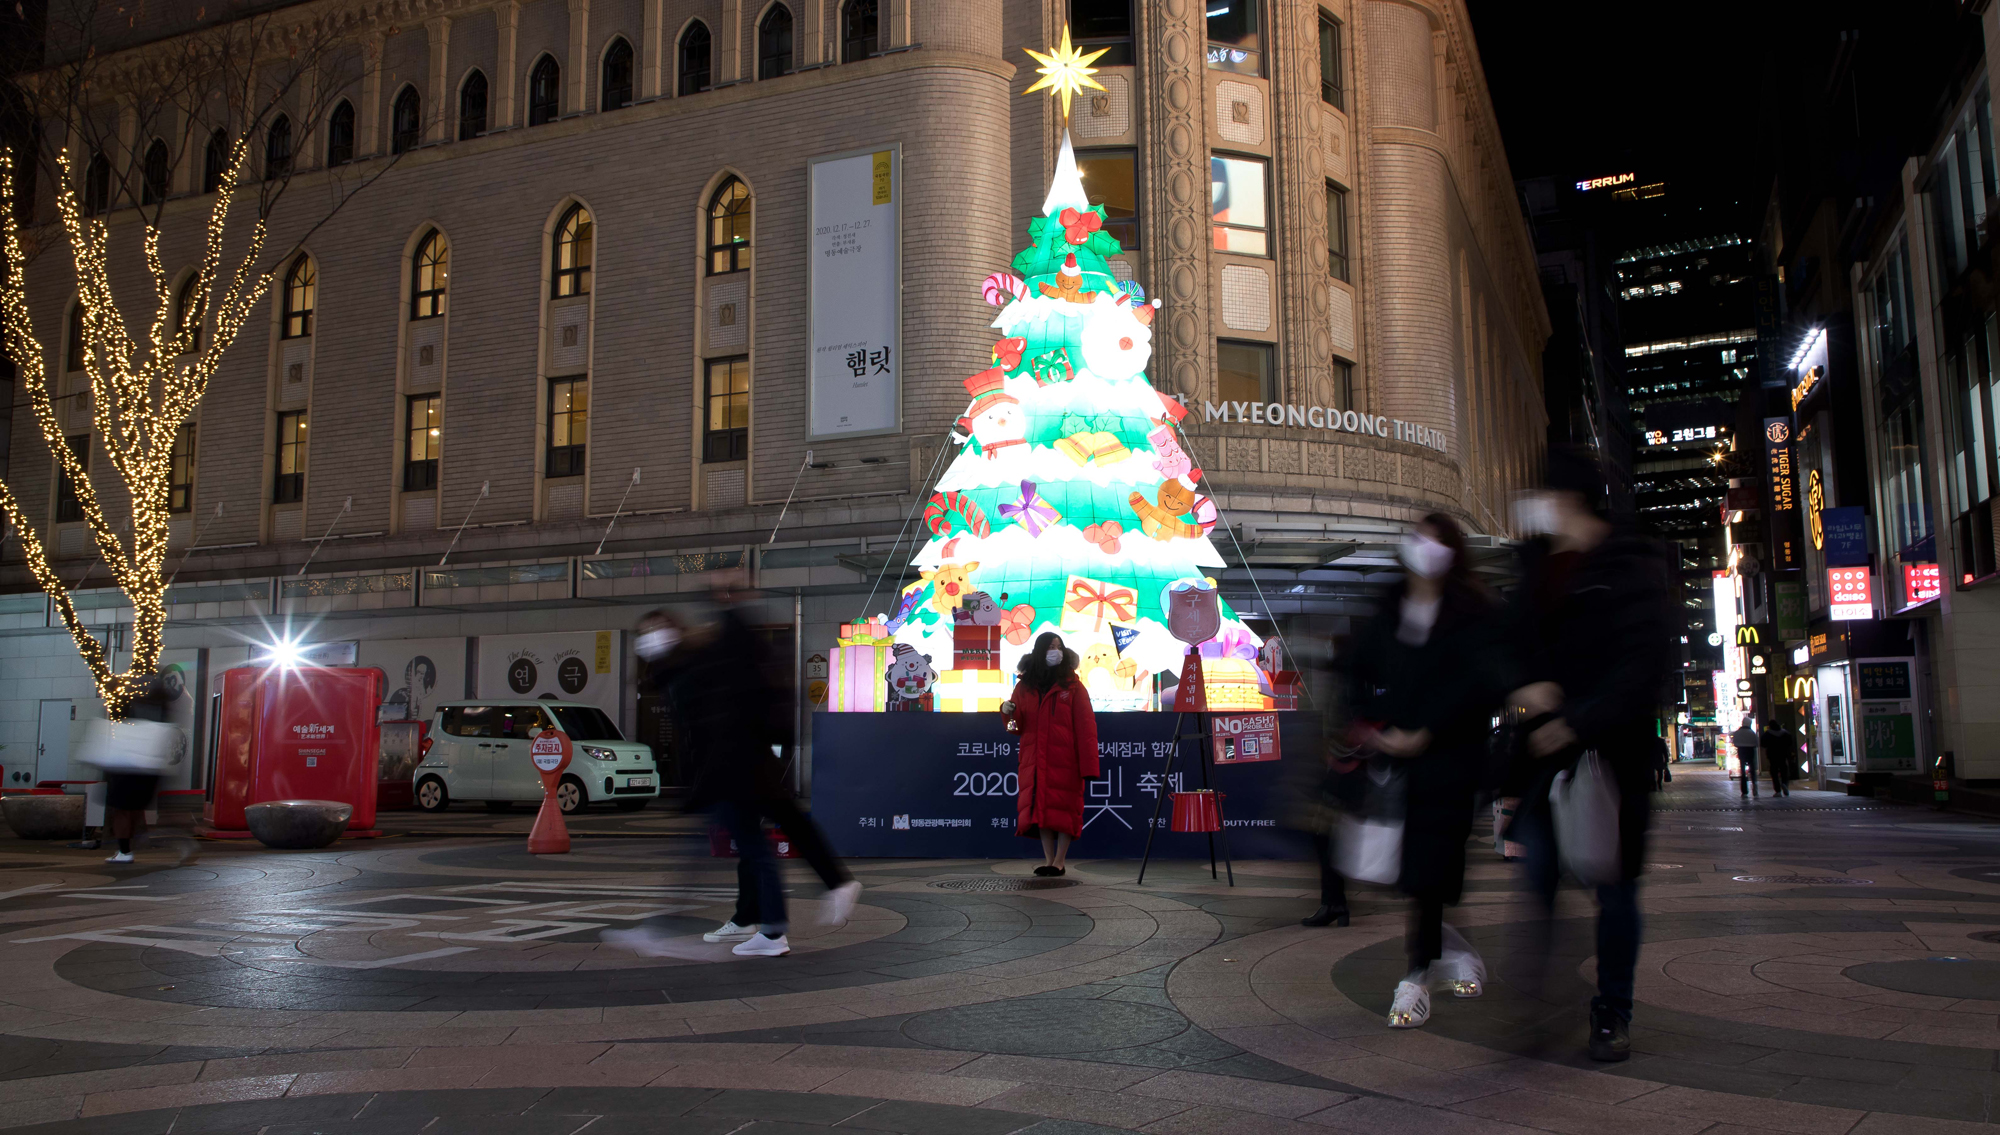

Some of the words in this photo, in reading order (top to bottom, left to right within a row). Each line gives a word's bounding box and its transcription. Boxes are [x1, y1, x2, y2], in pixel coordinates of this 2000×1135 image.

[845, 346, 890, 377] 햄릿
[1205, 400, 1388, 438] MYEONGDONG
[1392, 418, 1448, 453] THEATER
[1672, 426, 1716, 442] 교원그룹
[1779, 447, 1790, 476] TIGER
[1781, 478, 1793, 510] SUGAR
[1834, 591, 1866, 602] daiso
[1185, 594, 1203, 639] 구세군
[1833, 607, 1868, 616] 다이소
[507, 651, 520, 664] The
[521, 648, 535, 658] face
[552, 648, 580, 665] Theater
[514, 665, 529, 686] 연
[564, 666, 581, 686] 극
[1185, 662, 1197, 706] 자선냄비
[293, 723, 335, 733] 예술新세계
[1215, 717, 1243, 734] NO
[1242, 715, 1275, 726] CASH?
[1242, 723, 1275, 731] PROBLEM
[536, 743, 560, 753] 주차금지
[957, 742, 1010, 758] 코로나19
[1151, 741, 1178, 758] 함께
[953, 772, 1019, 796] 2020
[858, 817, 877, 828] 주최
[910, 818, 972, 828] 명동관광특구협의회
[990, 817, 1009, 828] 후원
[1223, 819, 1250, 827] DUTY
[1250, 819, 1276, 827] FREE
